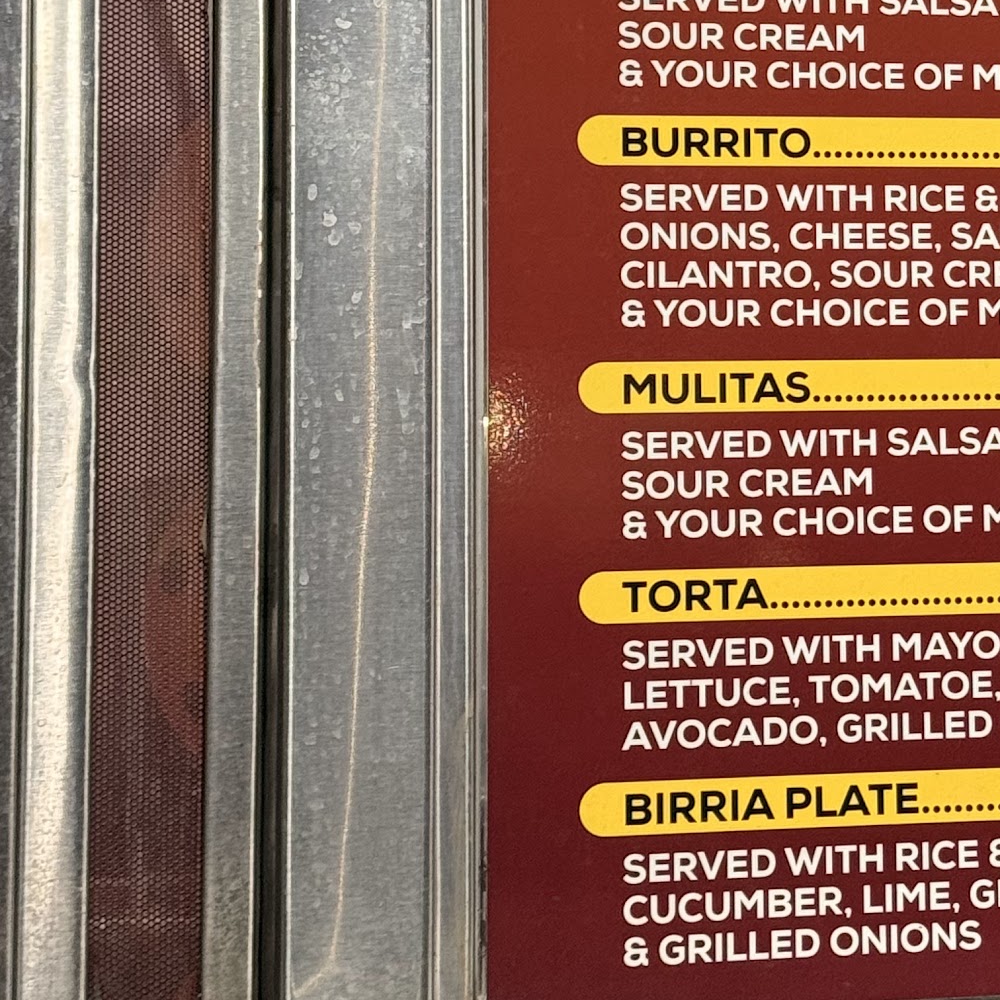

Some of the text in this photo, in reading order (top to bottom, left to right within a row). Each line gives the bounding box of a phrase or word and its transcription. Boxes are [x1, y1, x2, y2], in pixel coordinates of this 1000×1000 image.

[619, 21, 864, 51] SOUR CREAM
[619, 60, 643, 86] &
[651, 60, 757, 88] YOUR
[767, 61, 904, 89] CHOICE
[915, 63, 963, 90] OF
[620, 183, 768, 211] SERVED
[776, 185, 872, 211] WITH
[885, 185, 965, 212] RICE
[976, 185, 998, 211] &
[621, 222, 779, 252] ONIONS,
[790, 222, 941, 252] CHEESE,
[621, 260, 820, 291] CILANTRO,
[831, 260, 934, 288] SOUR
[622, 300, 645, 327] &
[654, 299, 760, 327] YOUR
[771, 299, 909, 326] CHOICE
[920, 298, 968, 325] OF
[622, 431, 771, 460] SERVED
[779, 429, 876, 457] WITH
[622, 468, 872, 500] SOUR CREAM
[623, 511, 646, 539] &
[655, 509, 763, 538] YOUR
[773, 506, 913, 536] CHOICE
[924, 505, 973, 533] OF
[623, 638, 773, 670] SERVED
[782, 634, 880, 664] WITH
[624, 677, 799, 710] LETTUCE,
[809, 671, 1000, 703] TOMATOE,
[622, 716, 826, 750] AVOCADO,
[837, 710, 992, 743] GRILLED
[626, 789, 774, 825] BIRRIA
[623, 849, 776, 884] SERVED
[784, 844, 883, 875] WITH
[896, 840, 979, 871] RICE
[623, 887, 854, 930] CUCUMBER,
[864, 882, 959, 913] LIME,
[624, 920, 981, 967] & GRILLED ONIONS
